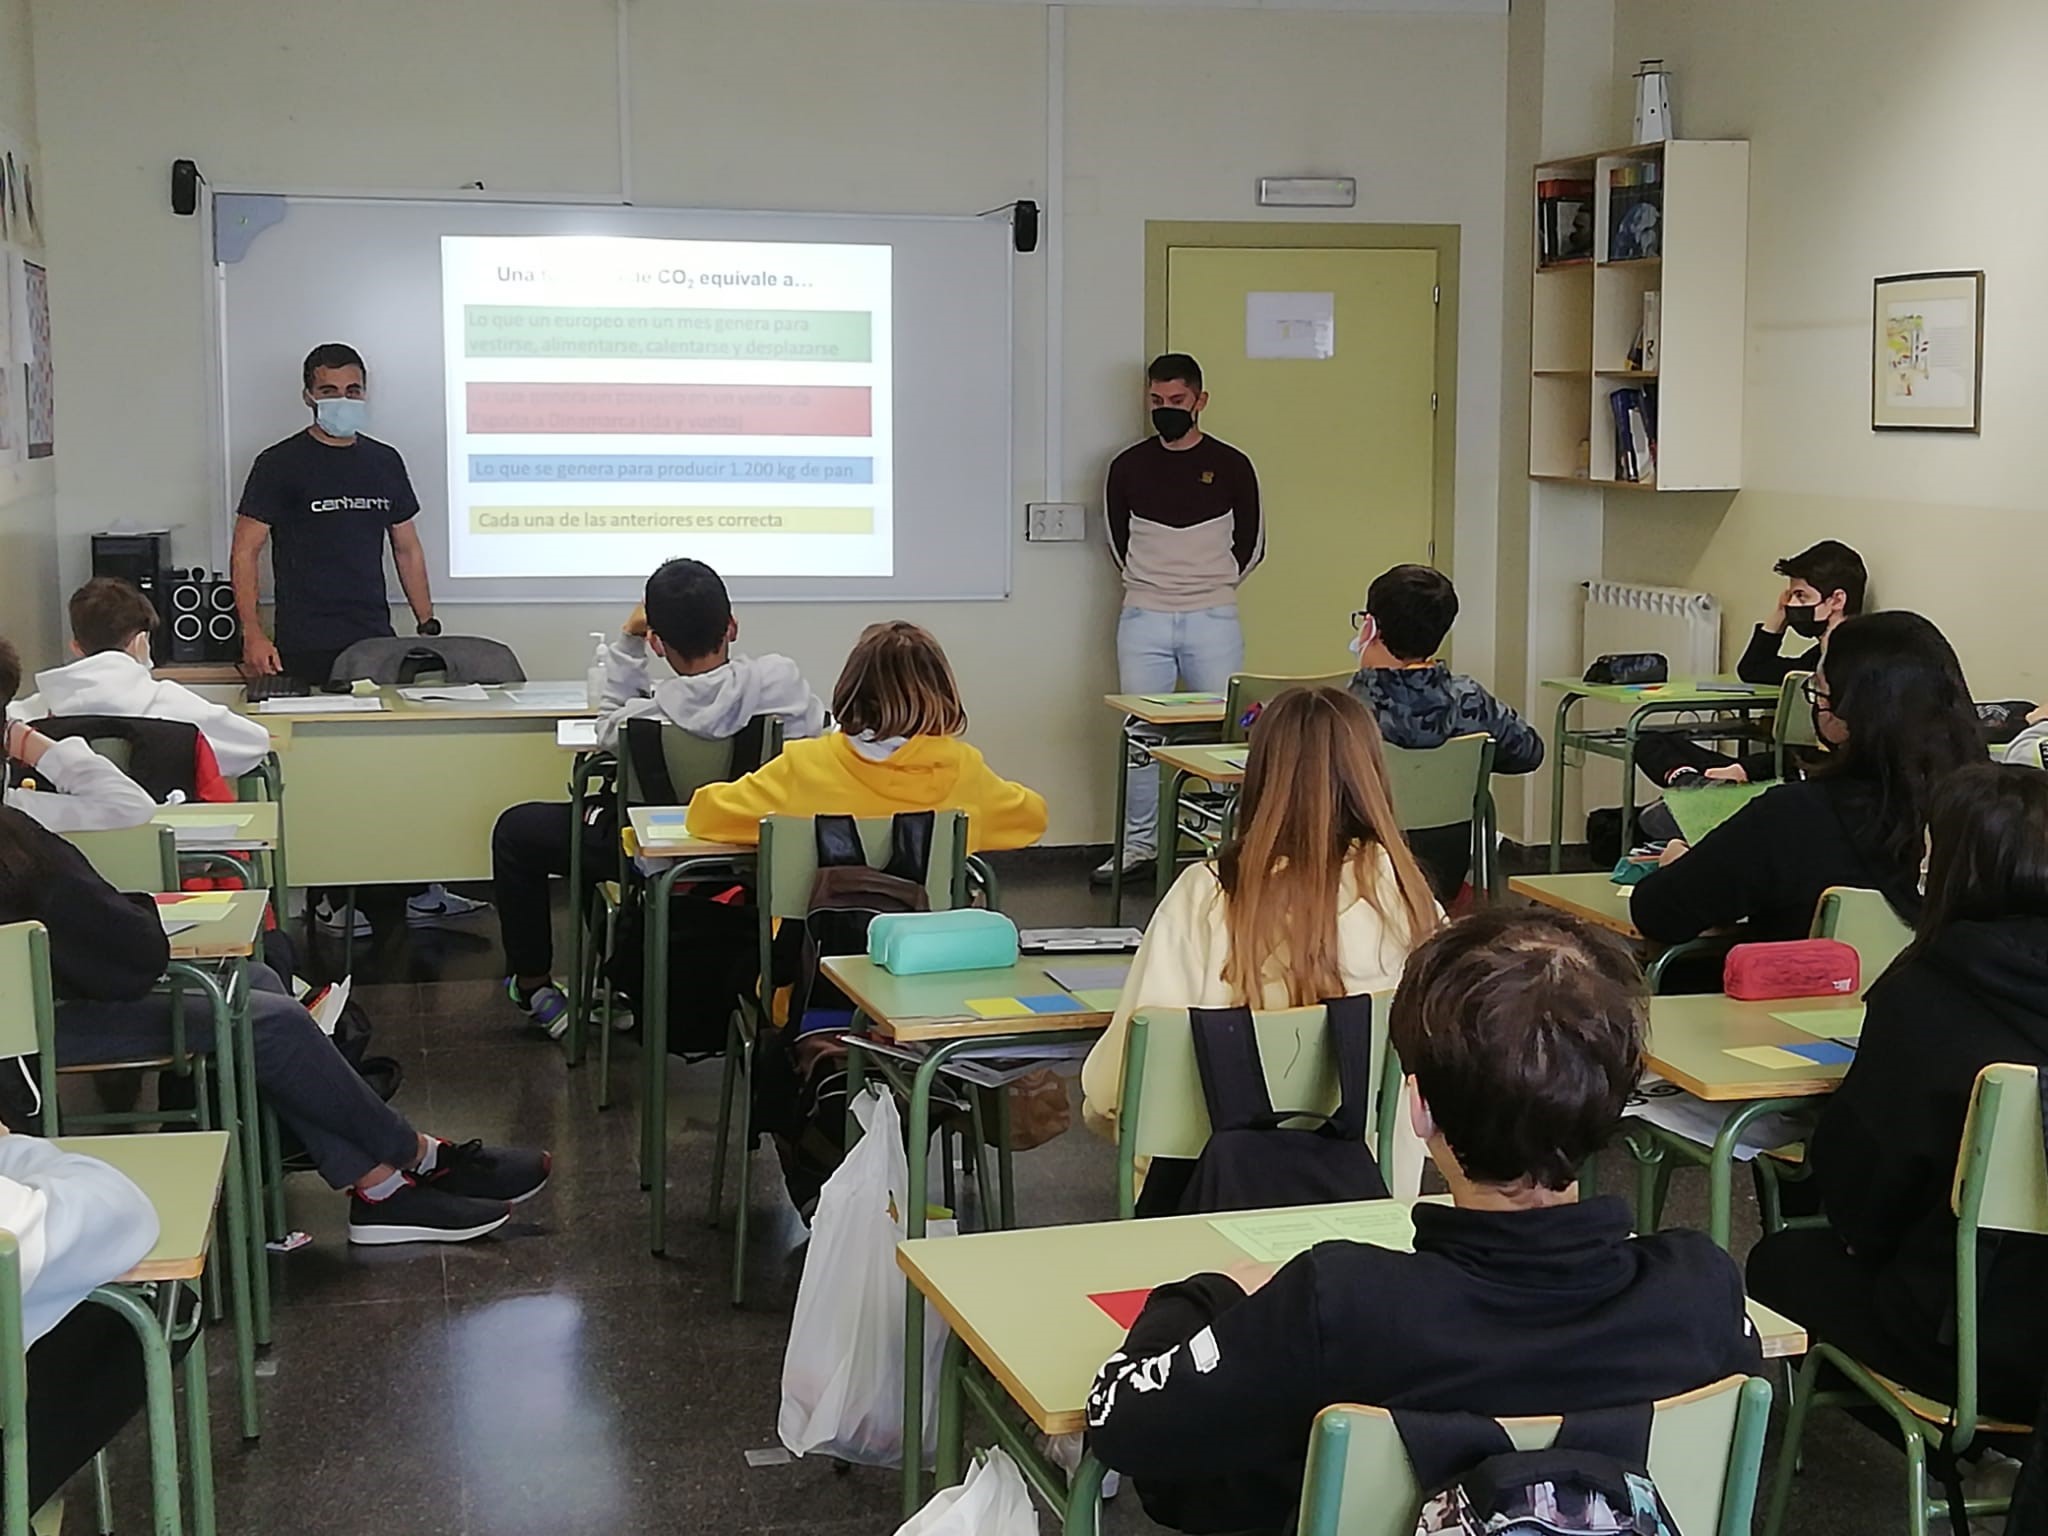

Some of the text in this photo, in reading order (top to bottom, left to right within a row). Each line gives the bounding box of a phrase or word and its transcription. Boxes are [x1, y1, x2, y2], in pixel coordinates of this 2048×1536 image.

[497, 266, 534, 282] Una
[700, 271, 777, 290] equivale
[468, 313, 809, 334] Lo que un europeo en un mes genera para
[646, 338, 729, 354] calentarse
[732, 343, 742, 357] y
[746, 338, 840, 357] desplazarse
[475, 461, 854, 481] Lo que se genera para producir 1.200 kg de pan
[310, 495, 390, 513] carhartt
[479, 512, 783, 527] Cada una de las anteriores es correcta
